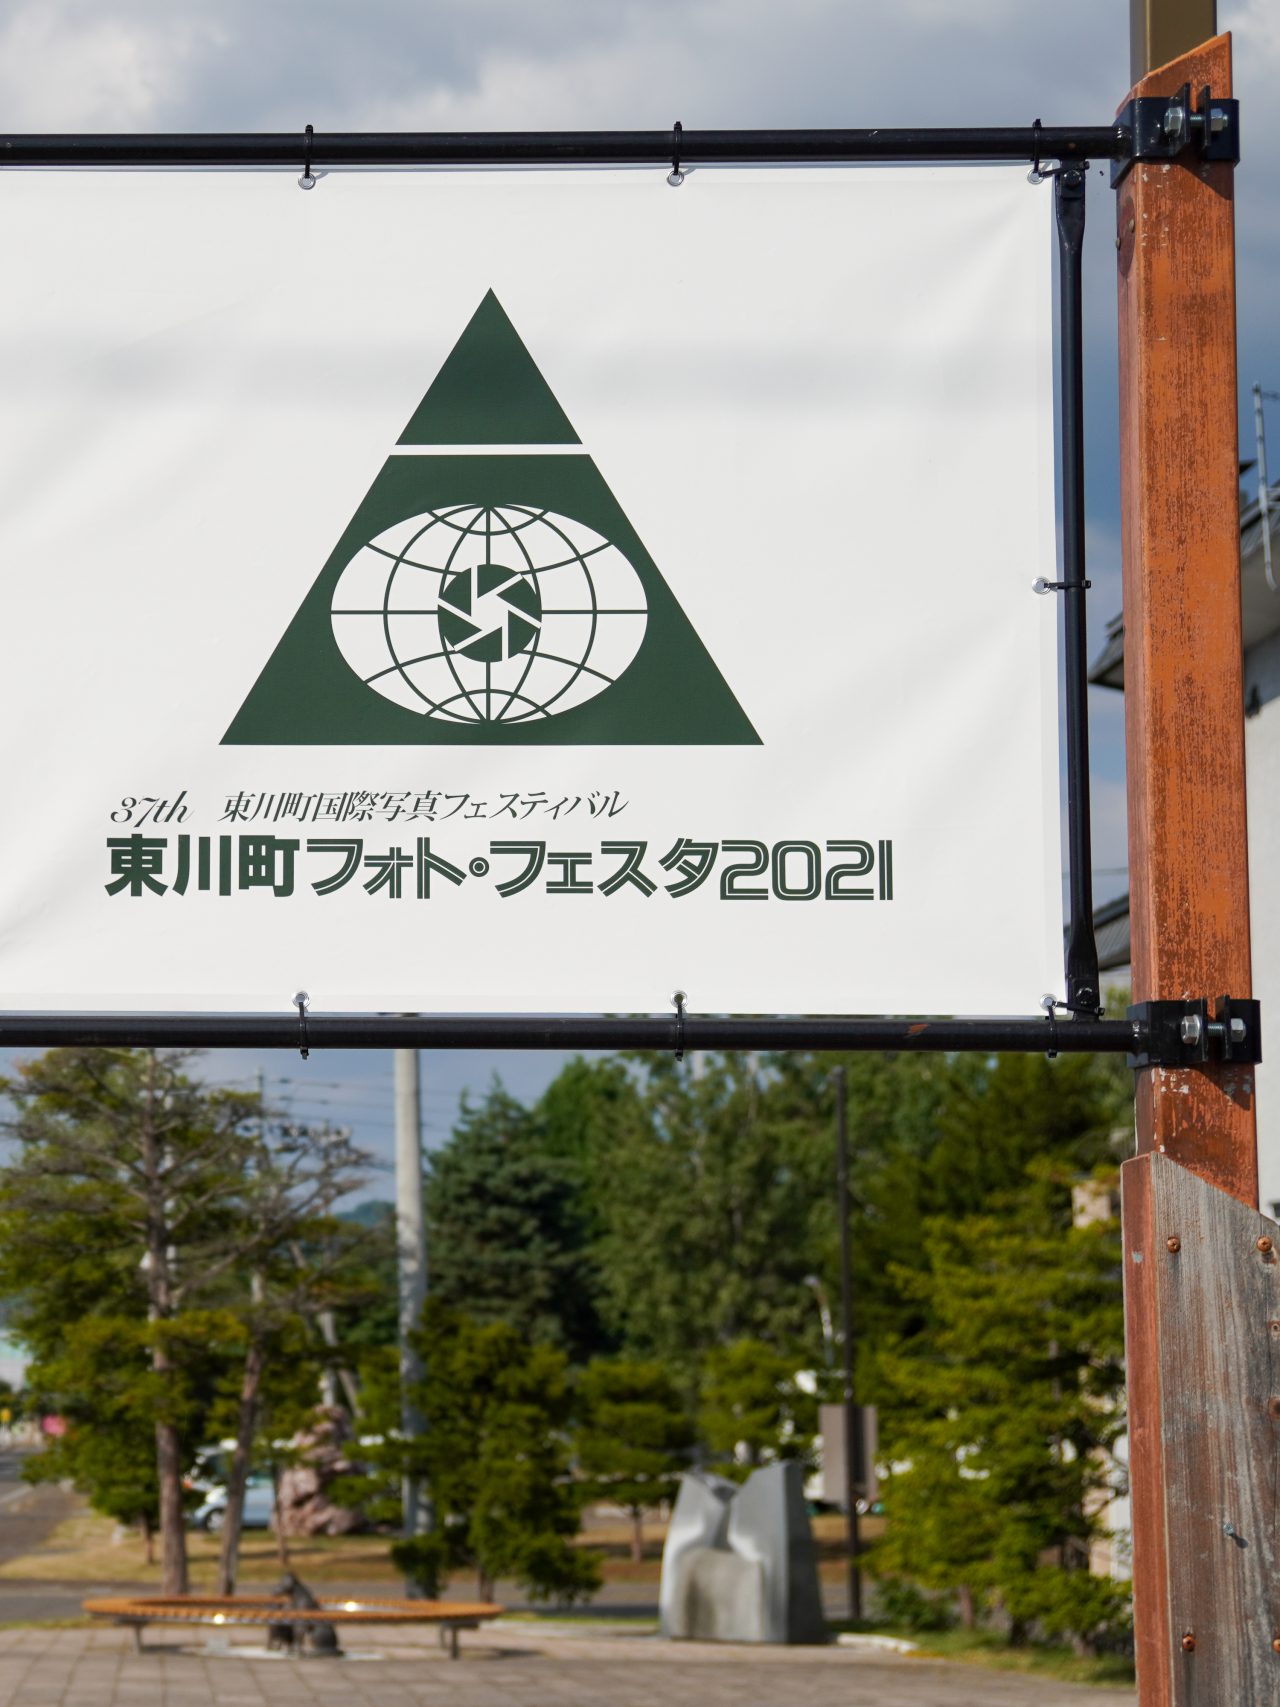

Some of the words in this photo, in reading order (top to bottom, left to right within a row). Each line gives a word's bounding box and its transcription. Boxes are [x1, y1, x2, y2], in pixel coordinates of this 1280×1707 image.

[110, 790, 194, 828] 37th
[218, 789, 628, 824] 東川町国際写真フェスティバル
